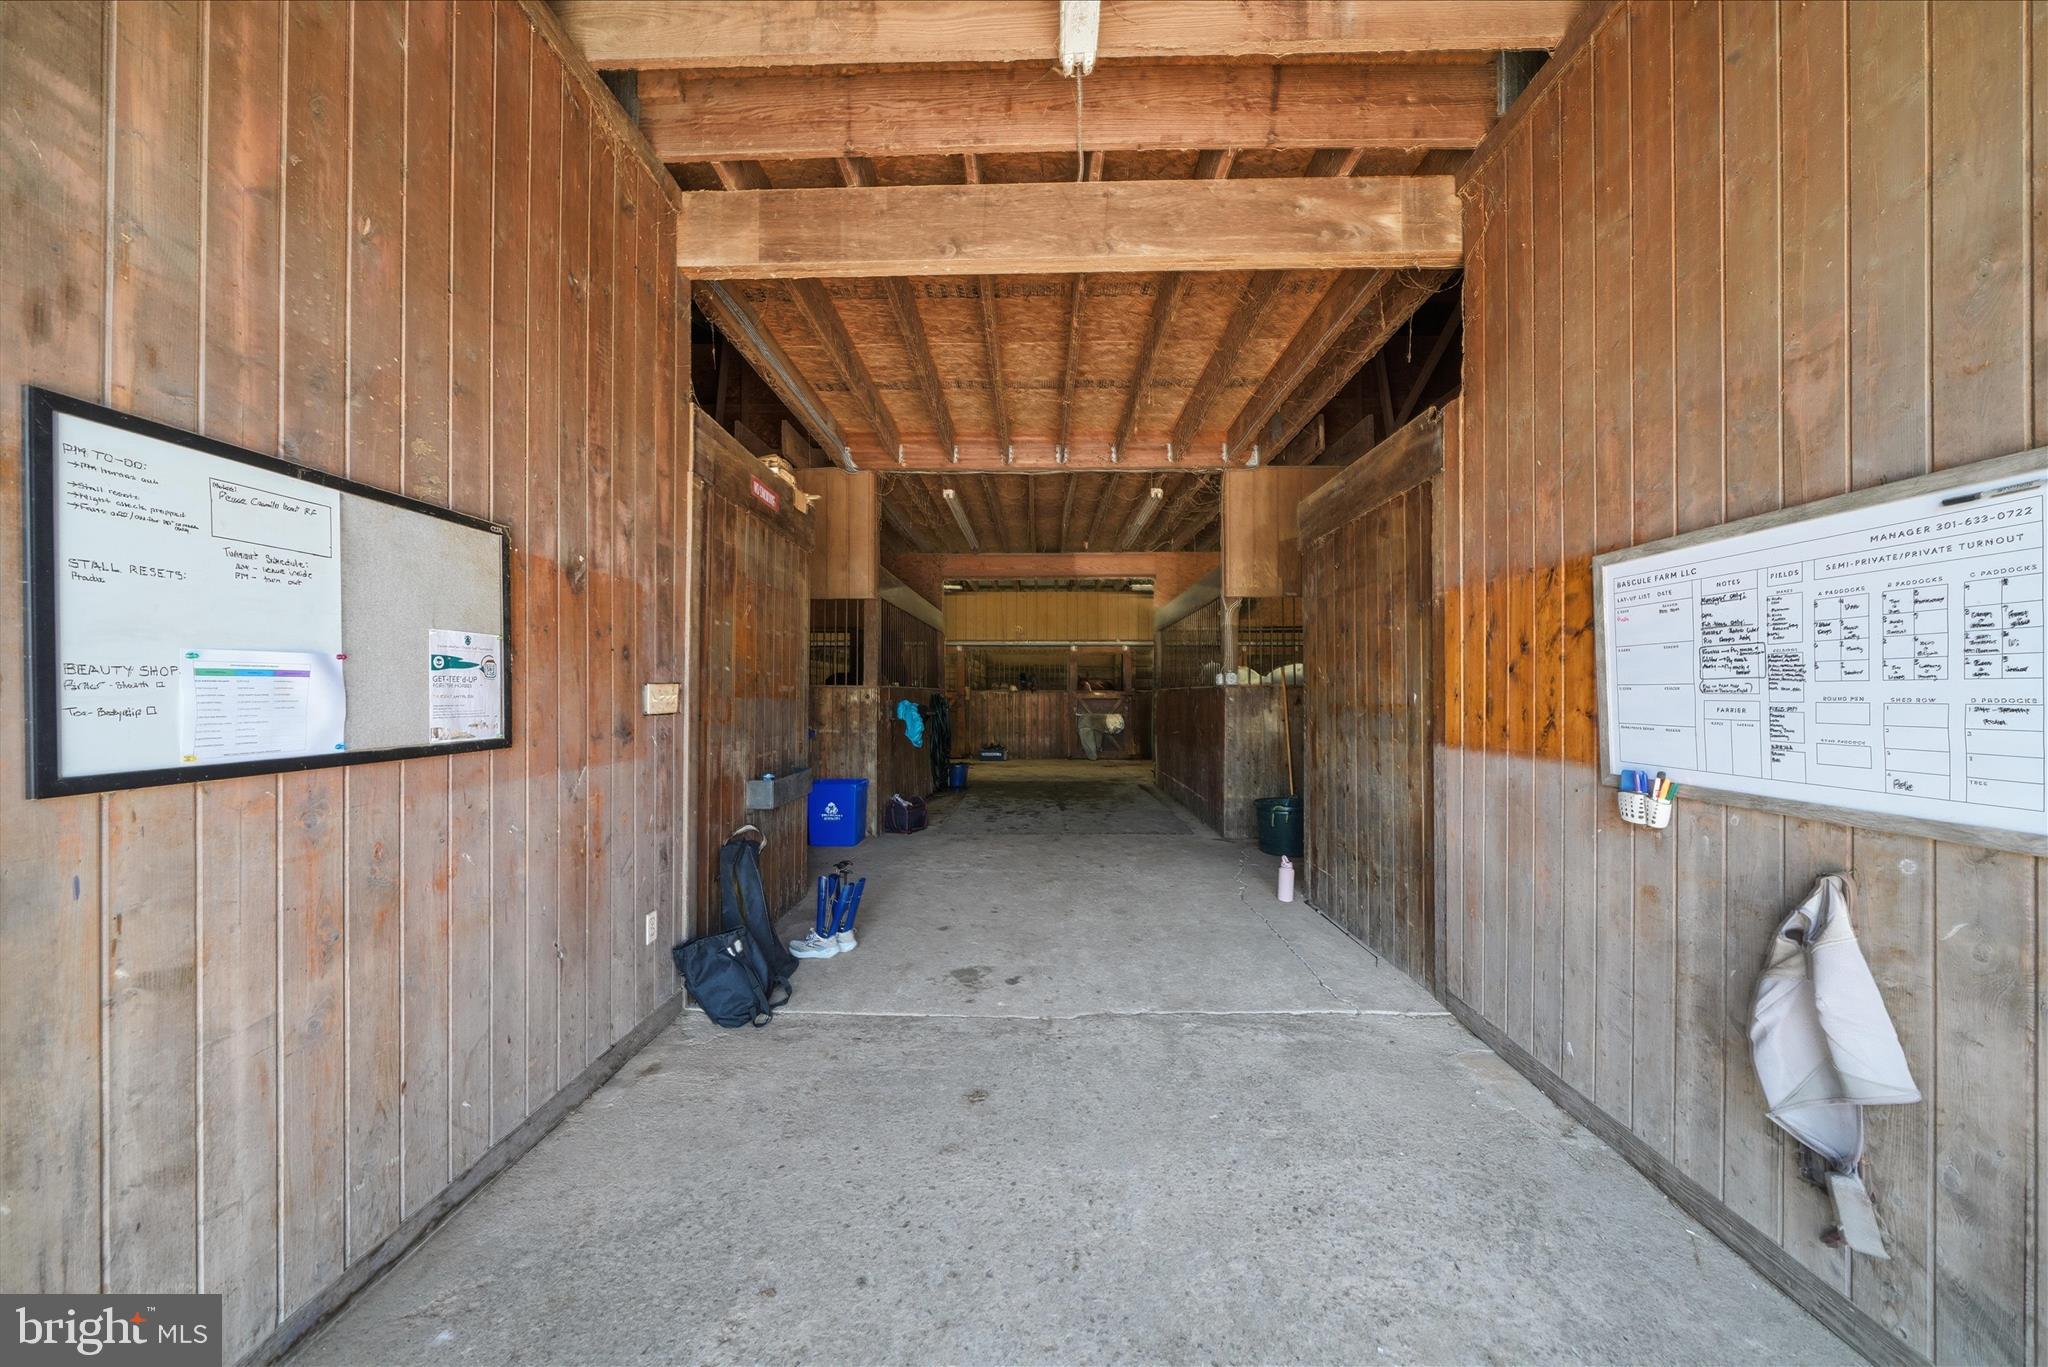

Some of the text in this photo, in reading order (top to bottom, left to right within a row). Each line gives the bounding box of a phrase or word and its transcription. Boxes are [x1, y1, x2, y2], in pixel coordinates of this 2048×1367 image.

[1870, 506, 2034, 543] MANAGER 301-633-0722
[1825, 533, 2025, 571] SEMI-PRIVATE/PRIVATE TURNOUT
[68, 558, 121, 573] STALL
[1980, 564, 2038, 577] PADDOCKS
[1616, 567, 1697, 589] BASCULE FARM LLC
[1770, 569, 1799, 579] FIELDS
[1716, 578, 1741, 587] NOTES
[1895, 576, 1943, 587] PADDOCKS
[1825, 585, 1865, 596] PADDOCKS
[63, 662, 133, 677] BEAUTY
